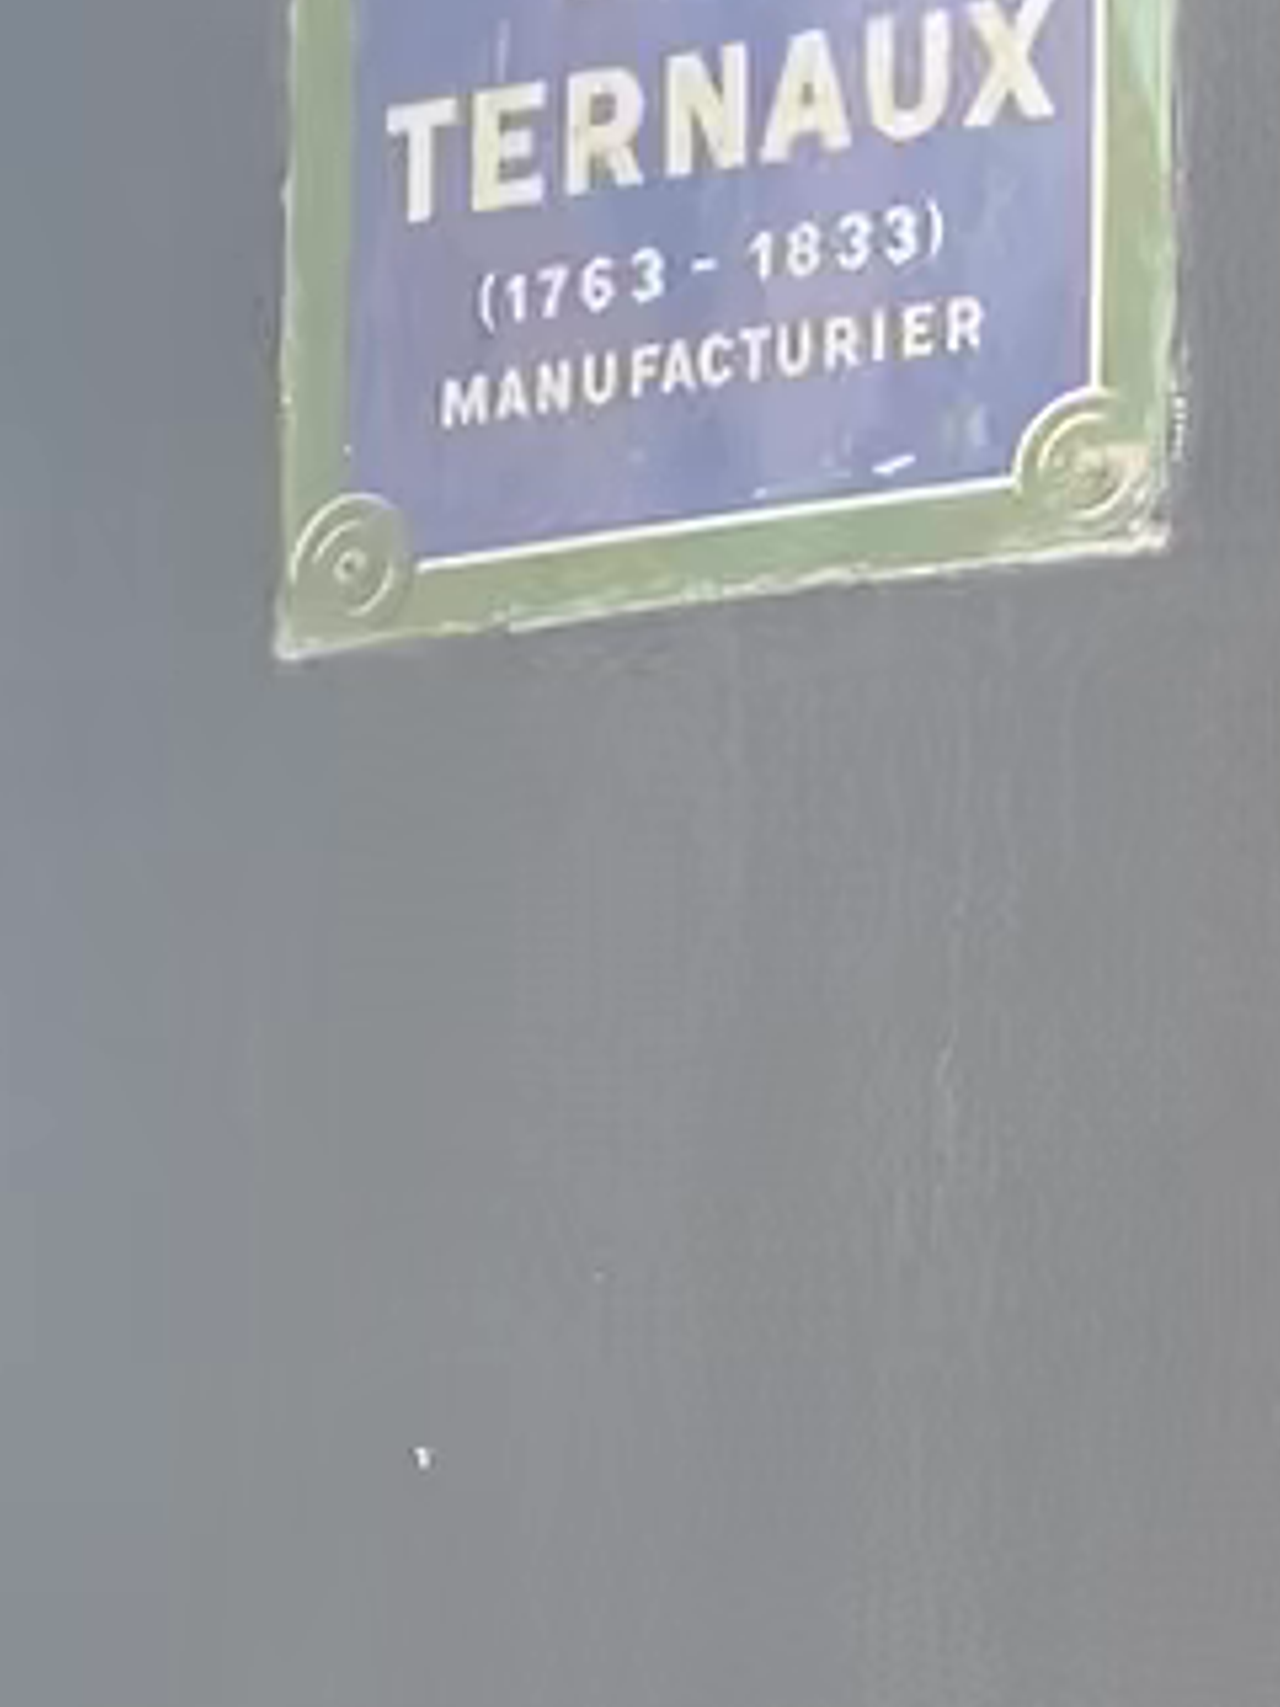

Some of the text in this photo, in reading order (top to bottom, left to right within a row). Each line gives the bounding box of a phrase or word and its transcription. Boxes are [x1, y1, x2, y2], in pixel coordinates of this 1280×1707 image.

[479, 247, 666, 335] (1763
[748, 199, 944, 283] 1833)
[440, 295, 984, 429] MANUFACTURIER
